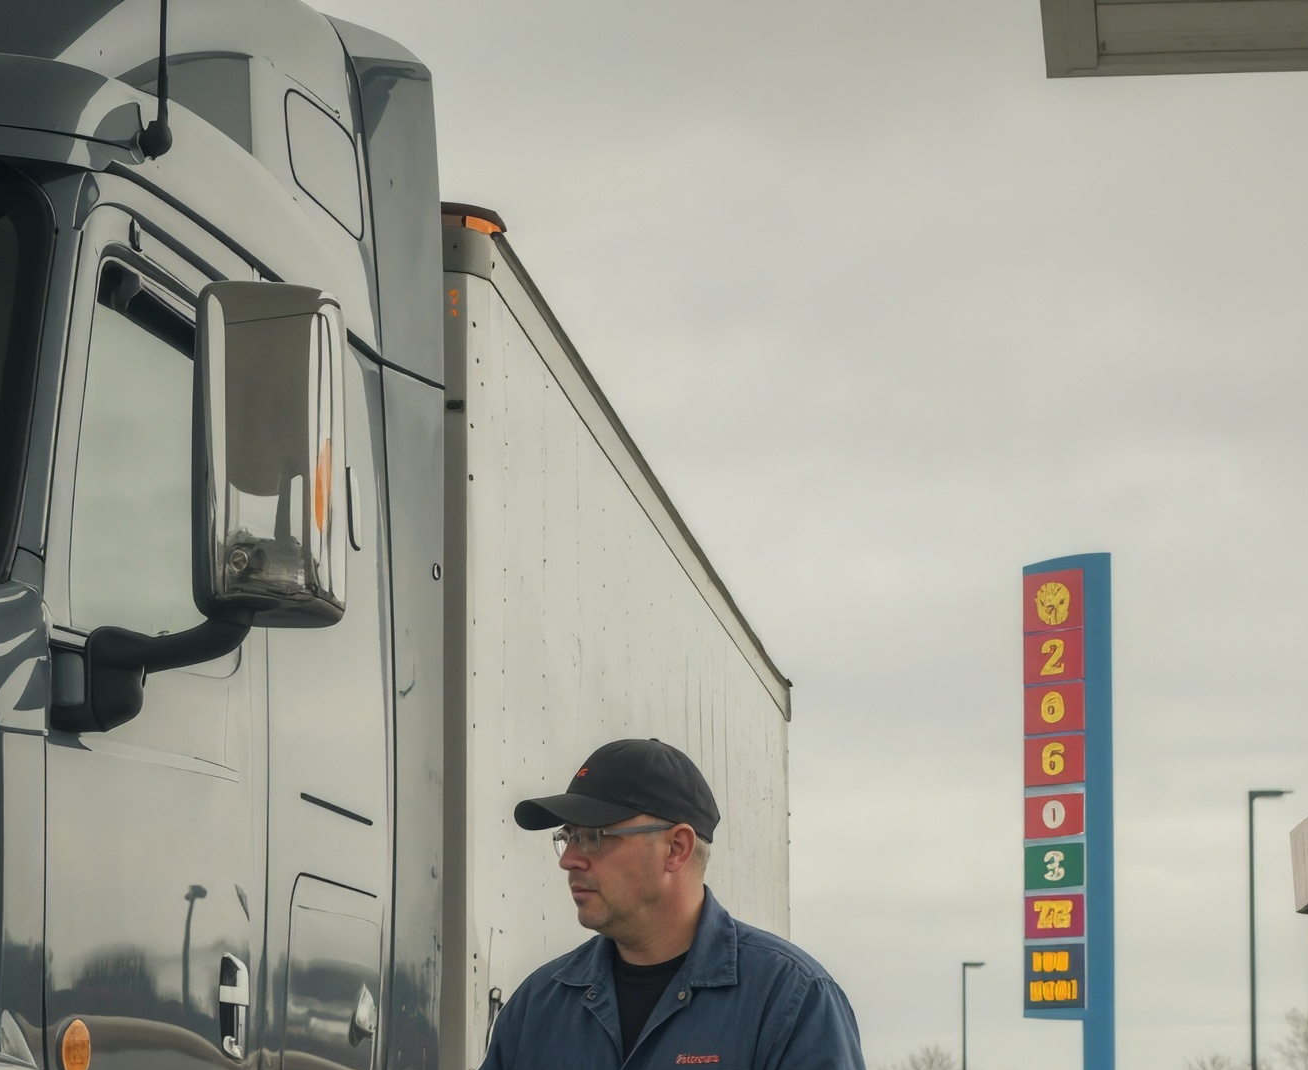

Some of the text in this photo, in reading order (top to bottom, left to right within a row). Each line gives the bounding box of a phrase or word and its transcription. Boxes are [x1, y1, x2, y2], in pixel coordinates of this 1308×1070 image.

[1040, 638, 1065, 676] 2
[1041, 742, 1065, 777] 6
[1043, 850, 1065, 882] 3
